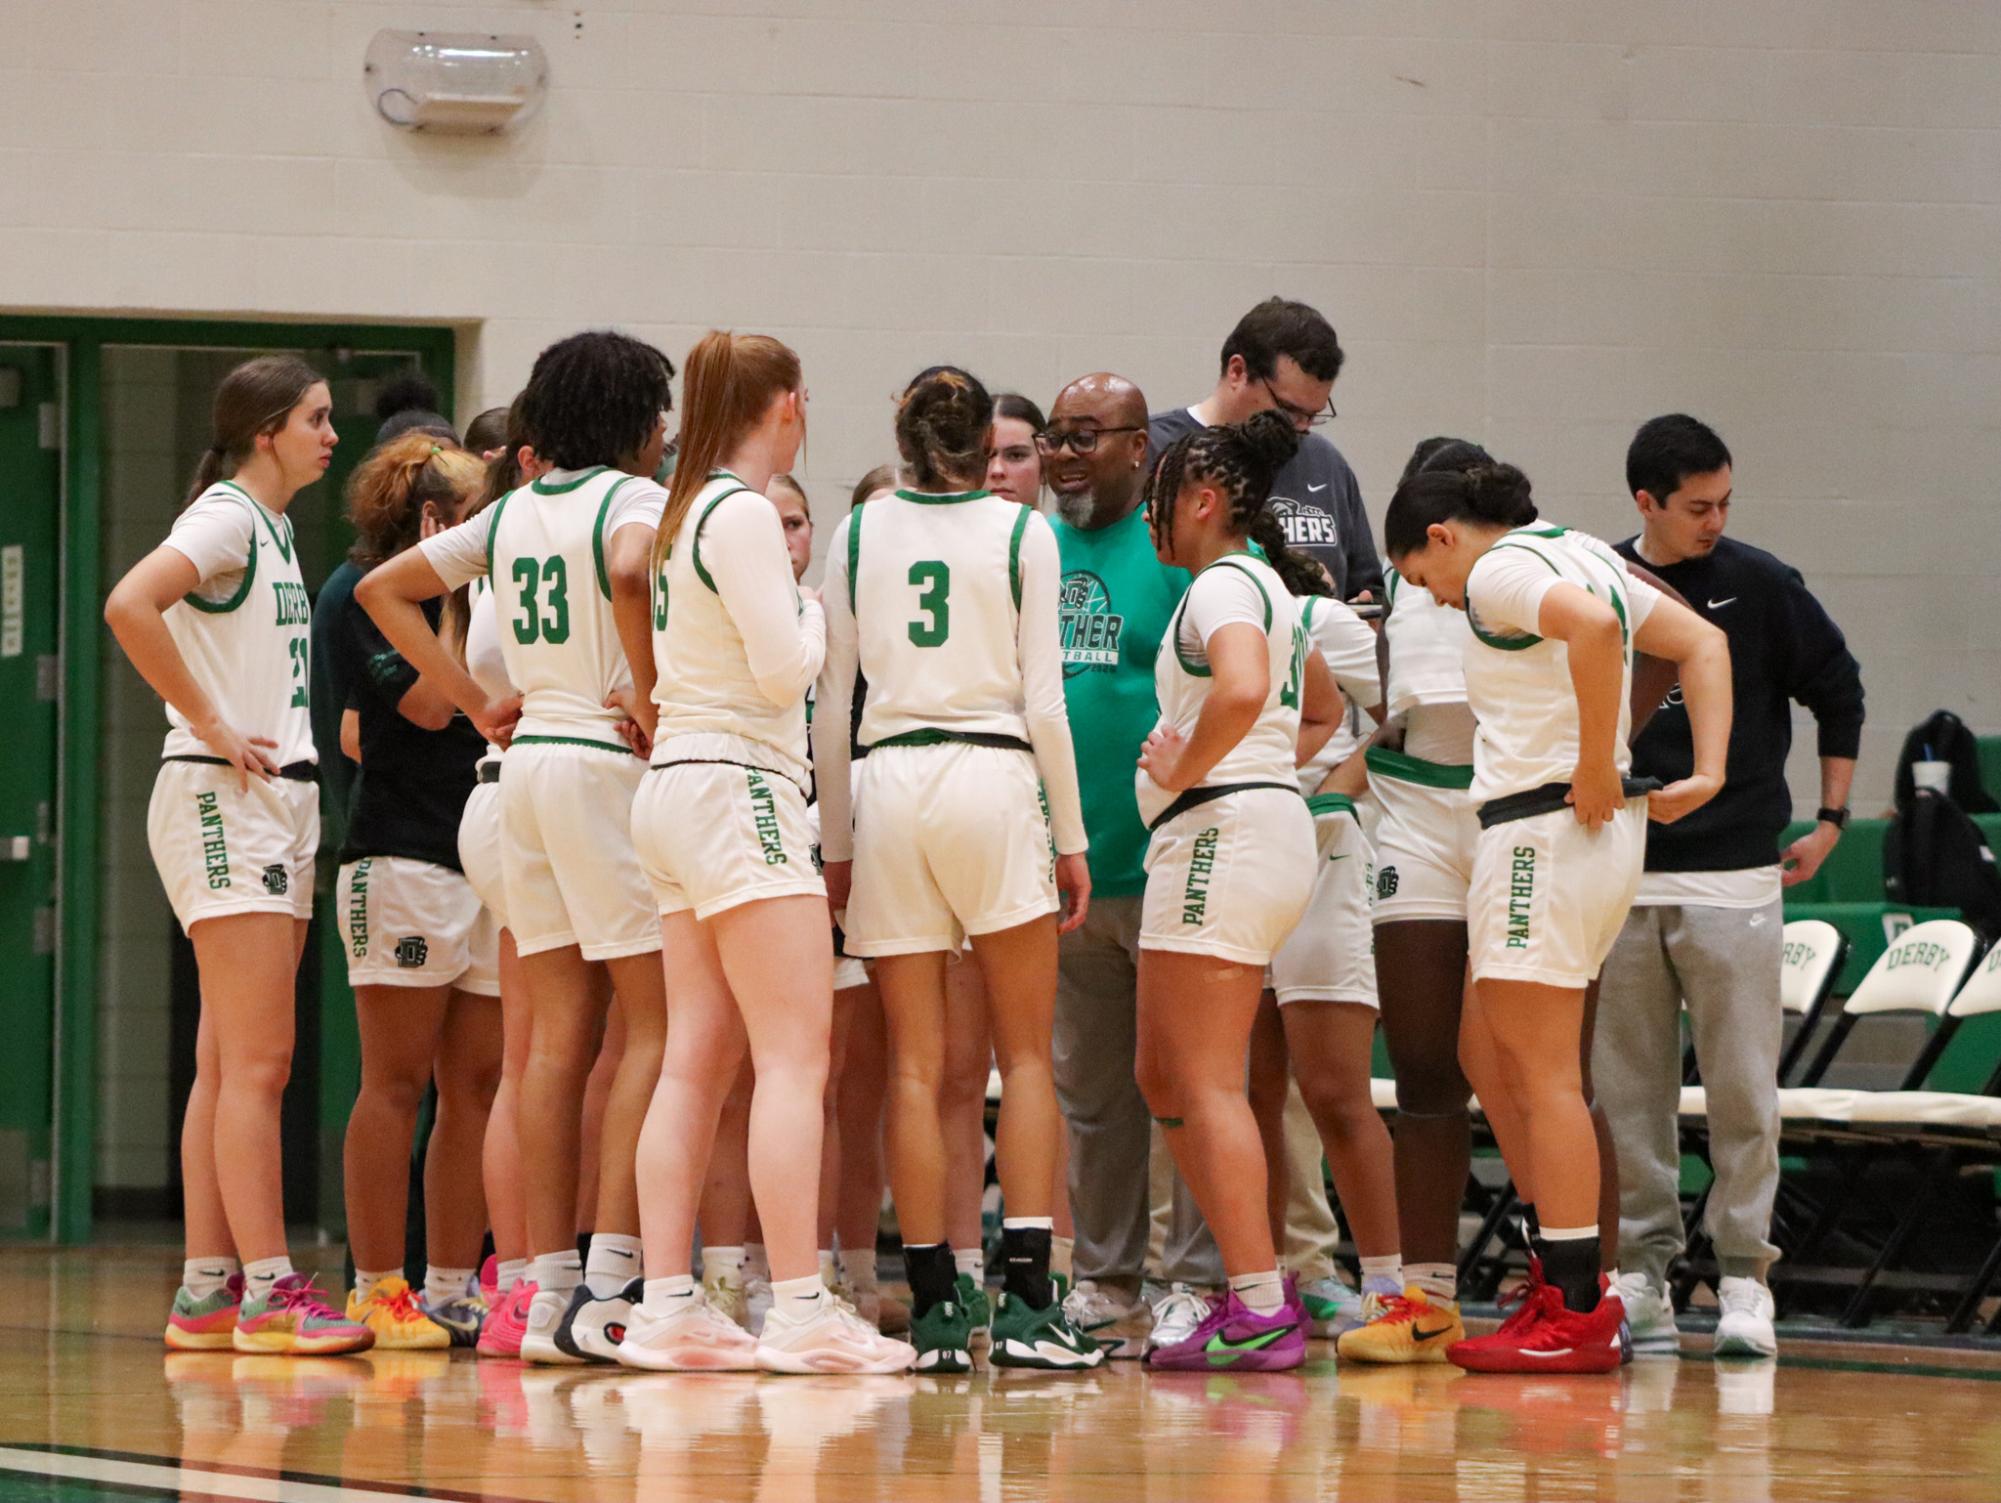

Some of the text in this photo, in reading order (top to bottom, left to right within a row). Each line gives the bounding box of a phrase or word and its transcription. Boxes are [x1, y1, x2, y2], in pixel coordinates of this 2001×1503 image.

[1278, 516, 1335, 543] HERS
[272, 582, 309, 626] DERB
[512, 554, 570, 645] 33
[908, 560, 950, 648] 3
[1060, 613, 1123, 650] THER
[1062, 650, 1113, 663] TBALL
[196, 791, 231, 890] PANTHERS
[1182, 827, 1220, 927] PANTHERS
[1505, 846, 1536, 950] PANTHERS
[1783, 942, 1816, 971] RBY
[1886, 942, 1951, 972] DERBY
